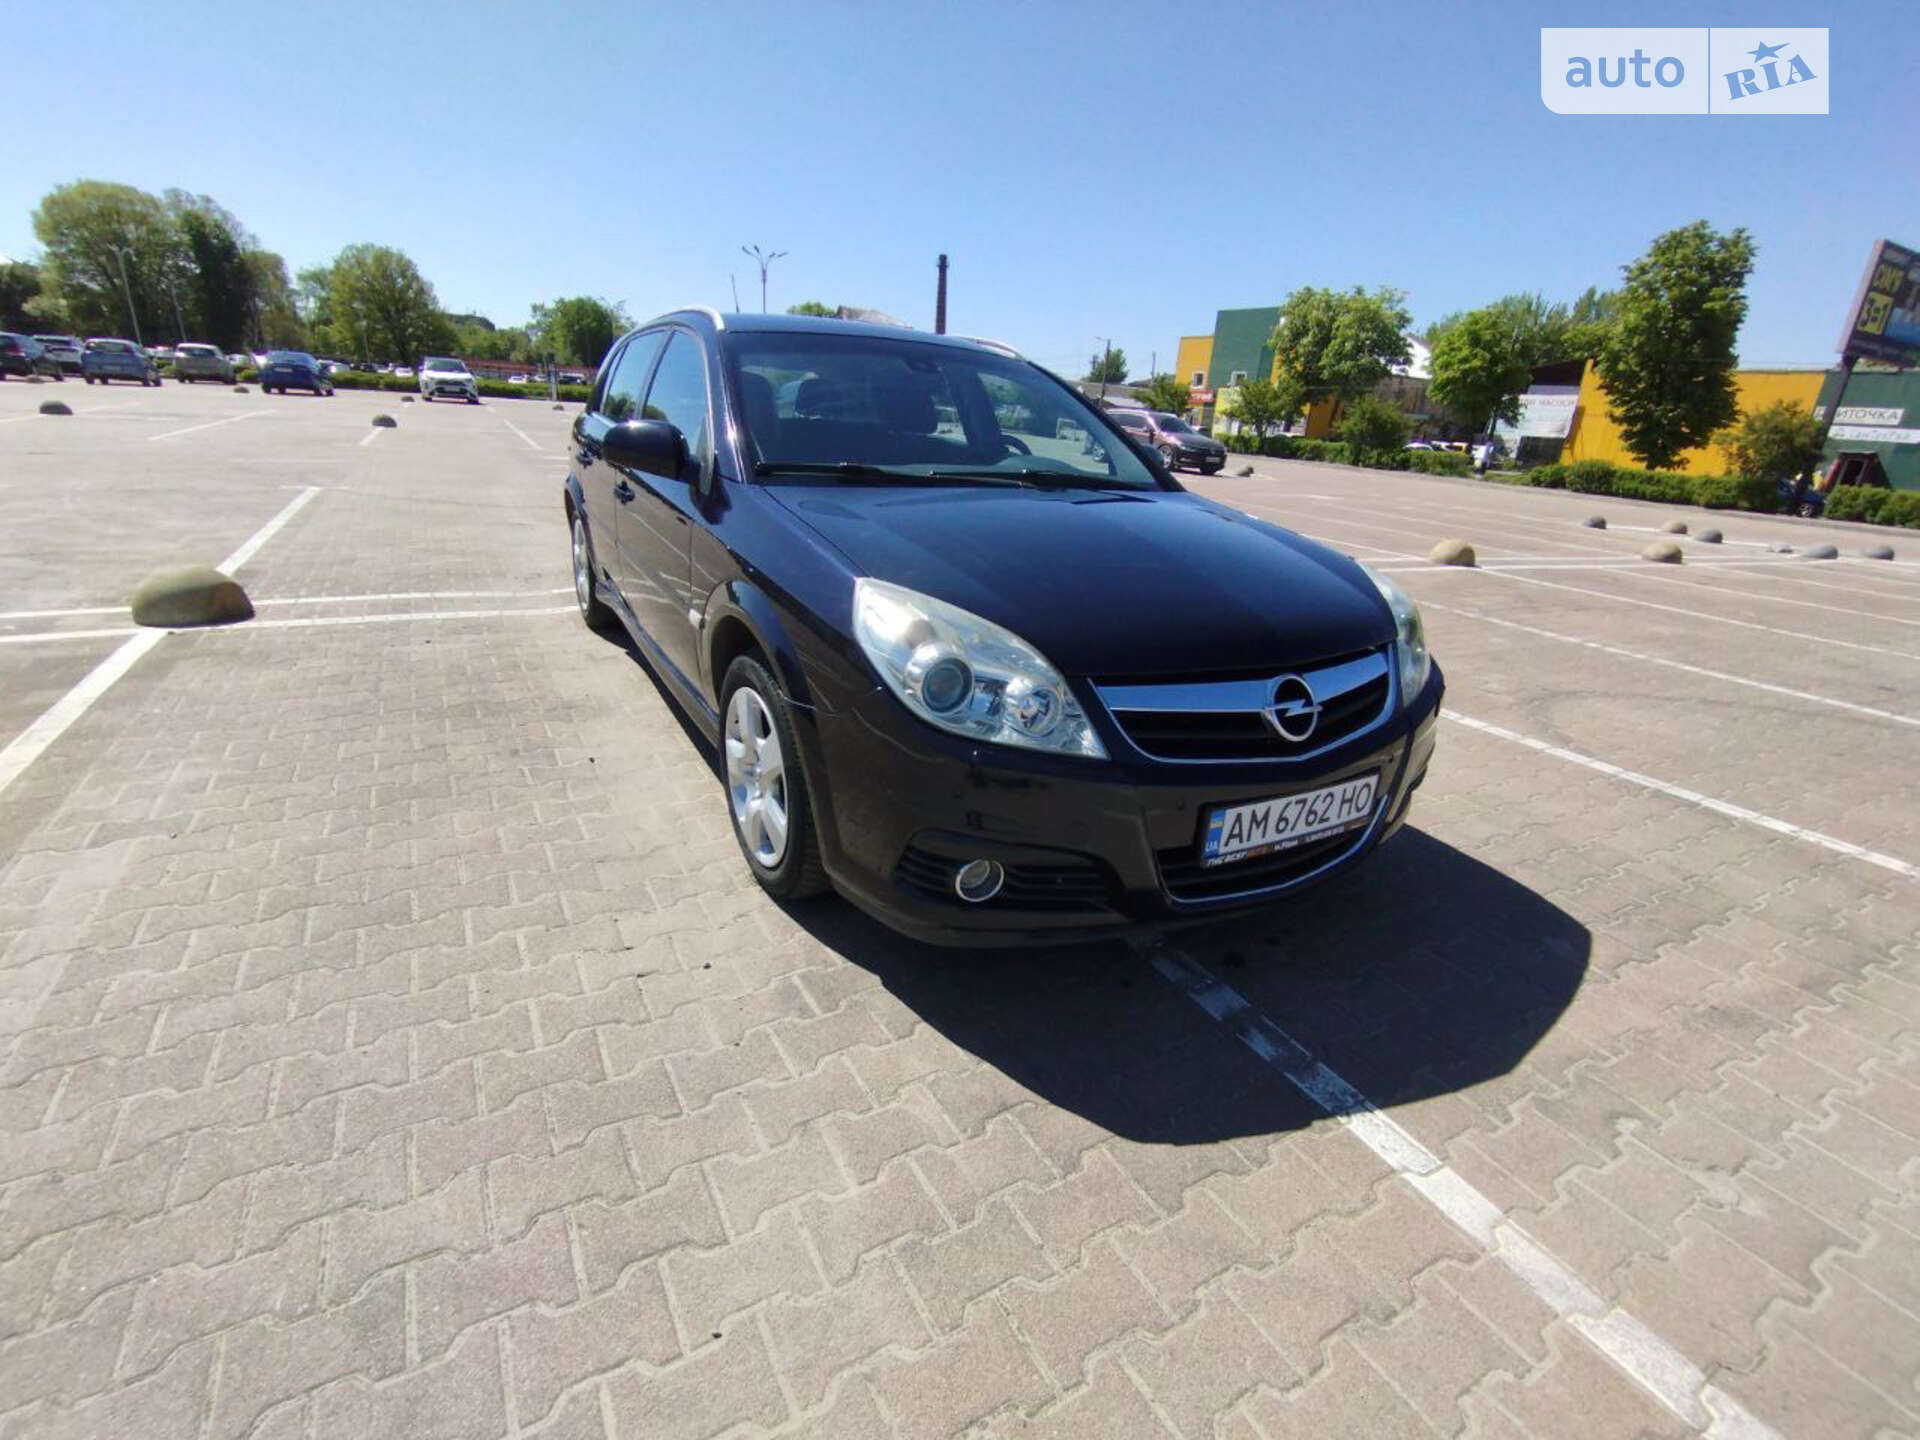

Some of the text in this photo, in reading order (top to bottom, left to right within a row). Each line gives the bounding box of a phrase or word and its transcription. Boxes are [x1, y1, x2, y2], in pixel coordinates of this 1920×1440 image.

[1224, 783, 1372, 847] AM 6762 HO
